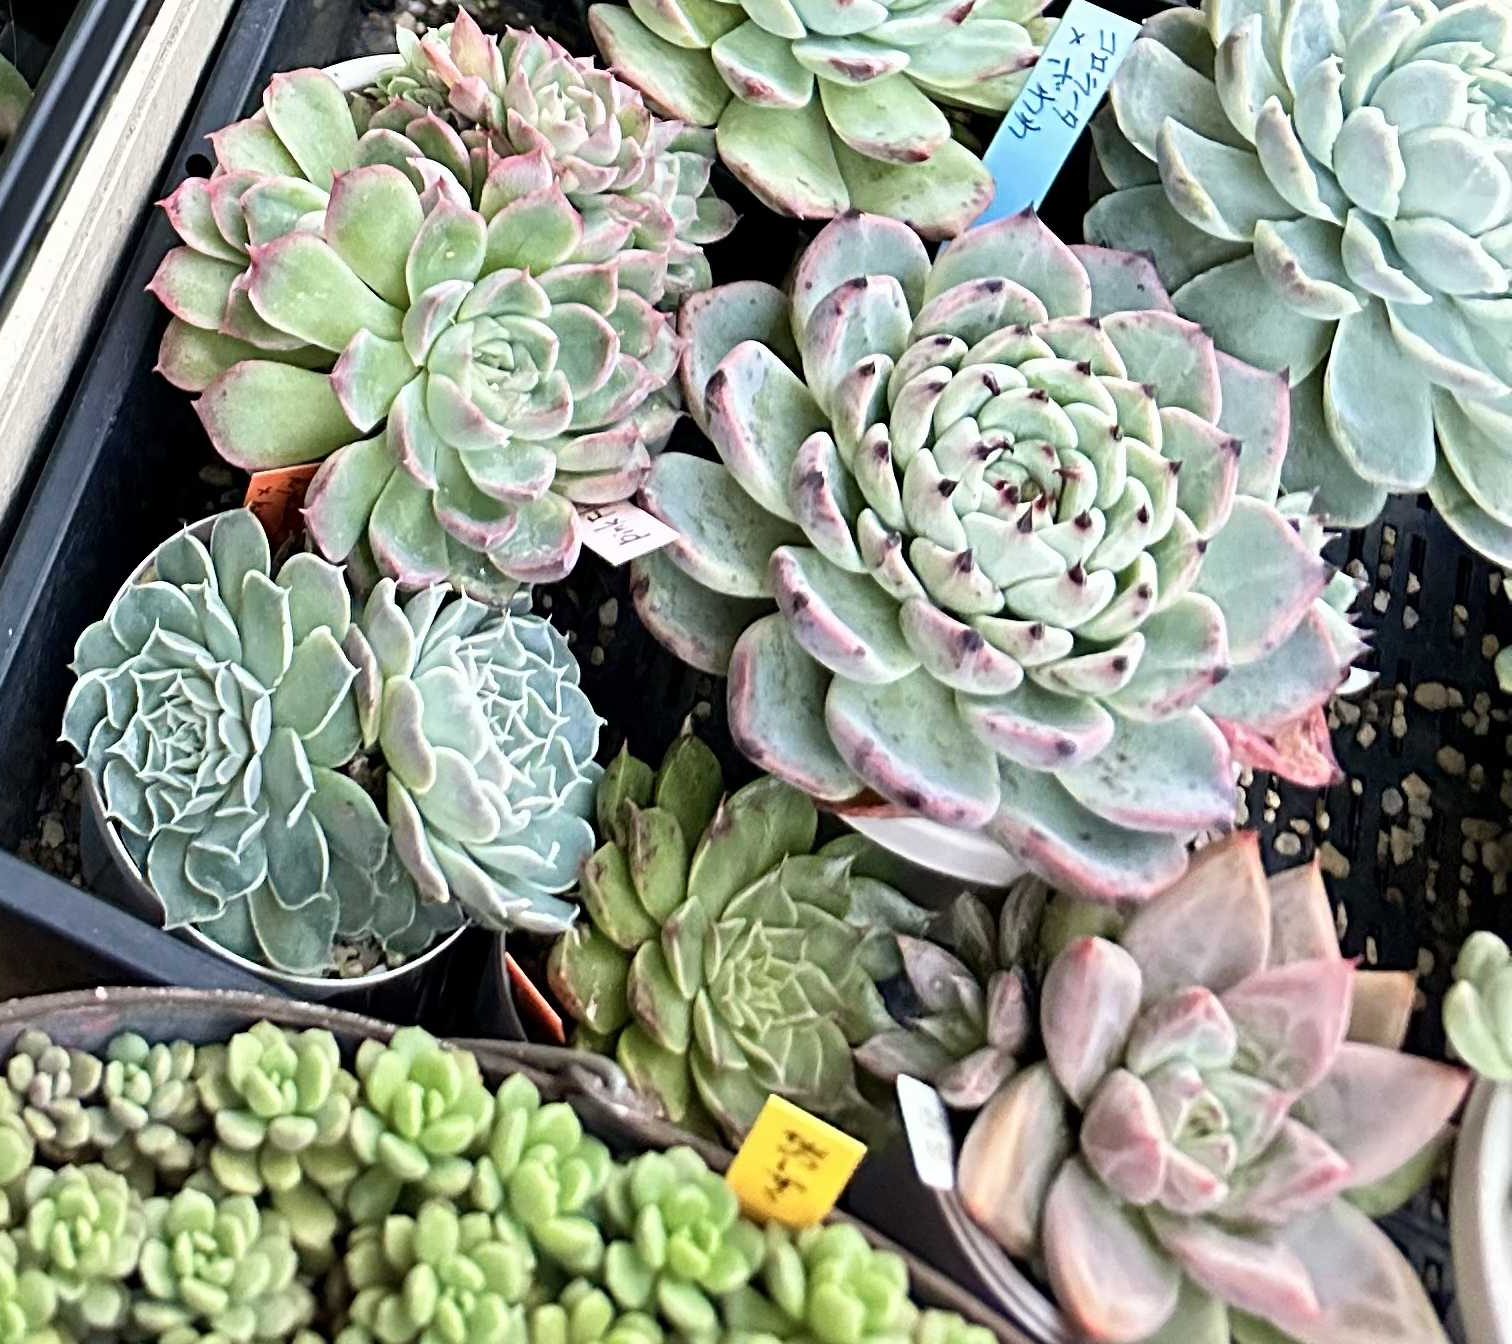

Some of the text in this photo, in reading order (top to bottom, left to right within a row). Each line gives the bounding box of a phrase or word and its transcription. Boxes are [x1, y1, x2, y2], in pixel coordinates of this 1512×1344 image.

[1052, 29, 1116, 129] コロラータ
